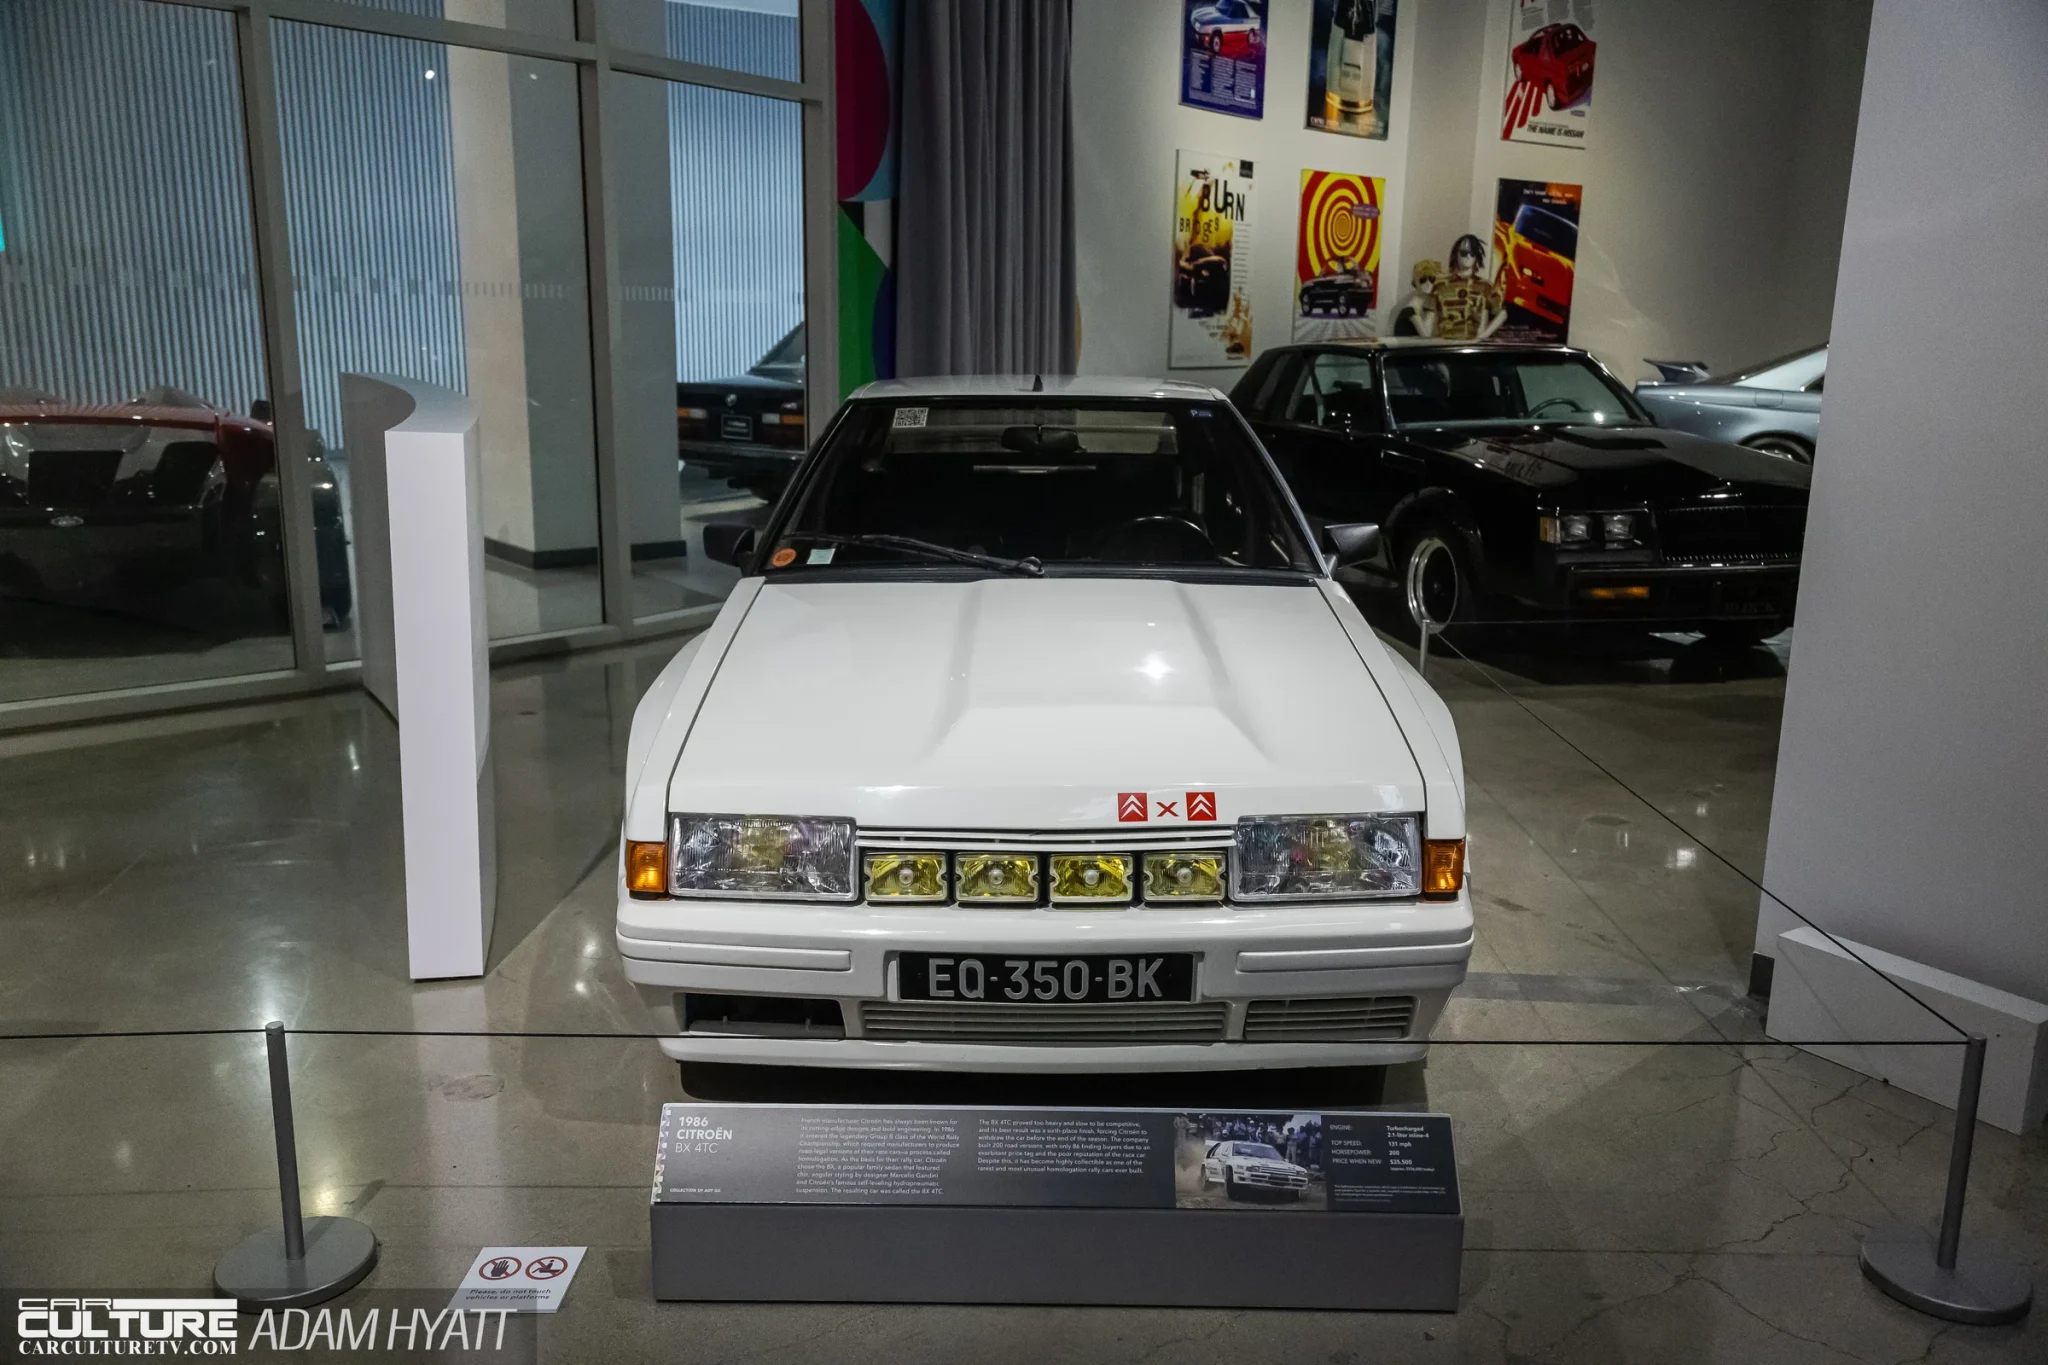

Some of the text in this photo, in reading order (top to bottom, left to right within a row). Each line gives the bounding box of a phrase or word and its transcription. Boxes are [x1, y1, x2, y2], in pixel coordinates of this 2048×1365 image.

[1201, 178, 1245, 222] BURN
[928, 958, 1164, 1000] EQ-350-BK
[678, 1116, 708, 1127] 1986
[676, 1127, 732, 1140] CITROËN
[675, 1142, 718, 1153] BX 4TC
